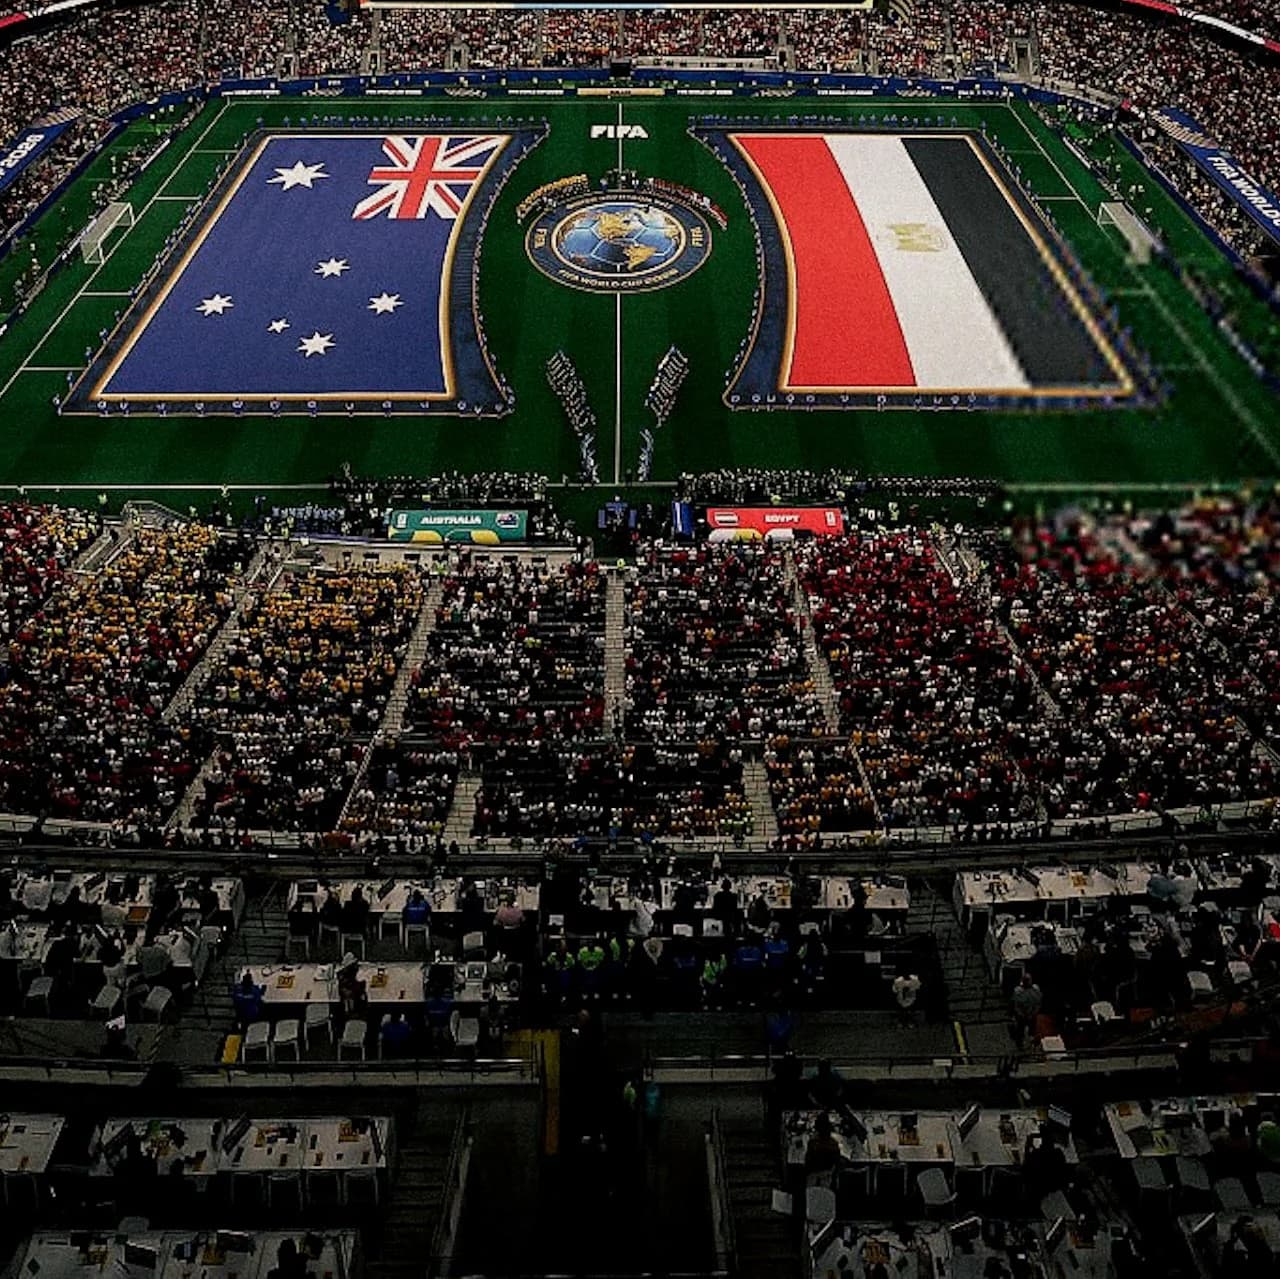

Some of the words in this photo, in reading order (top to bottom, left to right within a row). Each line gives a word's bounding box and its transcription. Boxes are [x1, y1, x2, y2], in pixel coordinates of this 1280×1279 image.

[590, 124, 649, 139] FIFA
[0, 133, 46, 169] 2026
[1207, 156, 1240, 180] FIFA
[581, 277, 620, 289] WORLD
[420, 515, 482, 525] AUSTRALIA
[764, 514, 800, 523] EGYPT
